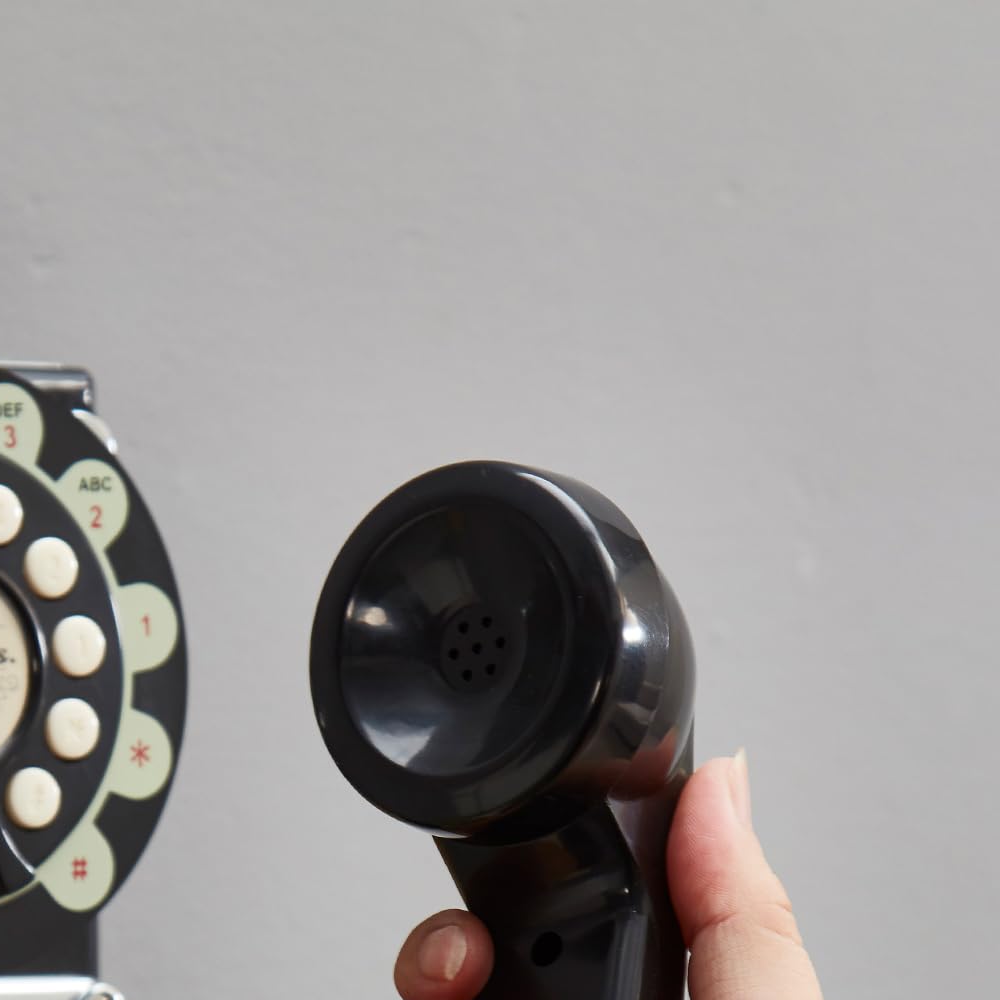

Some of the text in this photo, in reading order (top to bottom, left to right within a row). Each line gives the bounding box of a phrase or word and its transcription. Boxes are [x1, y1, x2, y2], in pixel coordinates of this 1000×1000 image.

[4, 426, 17, 448] 3
[78, 476, 112, 492] ABC
[91, 506, 103, 528] 2
[141, 616, 151, 636] 1
[71, 857, 88, 880] #
